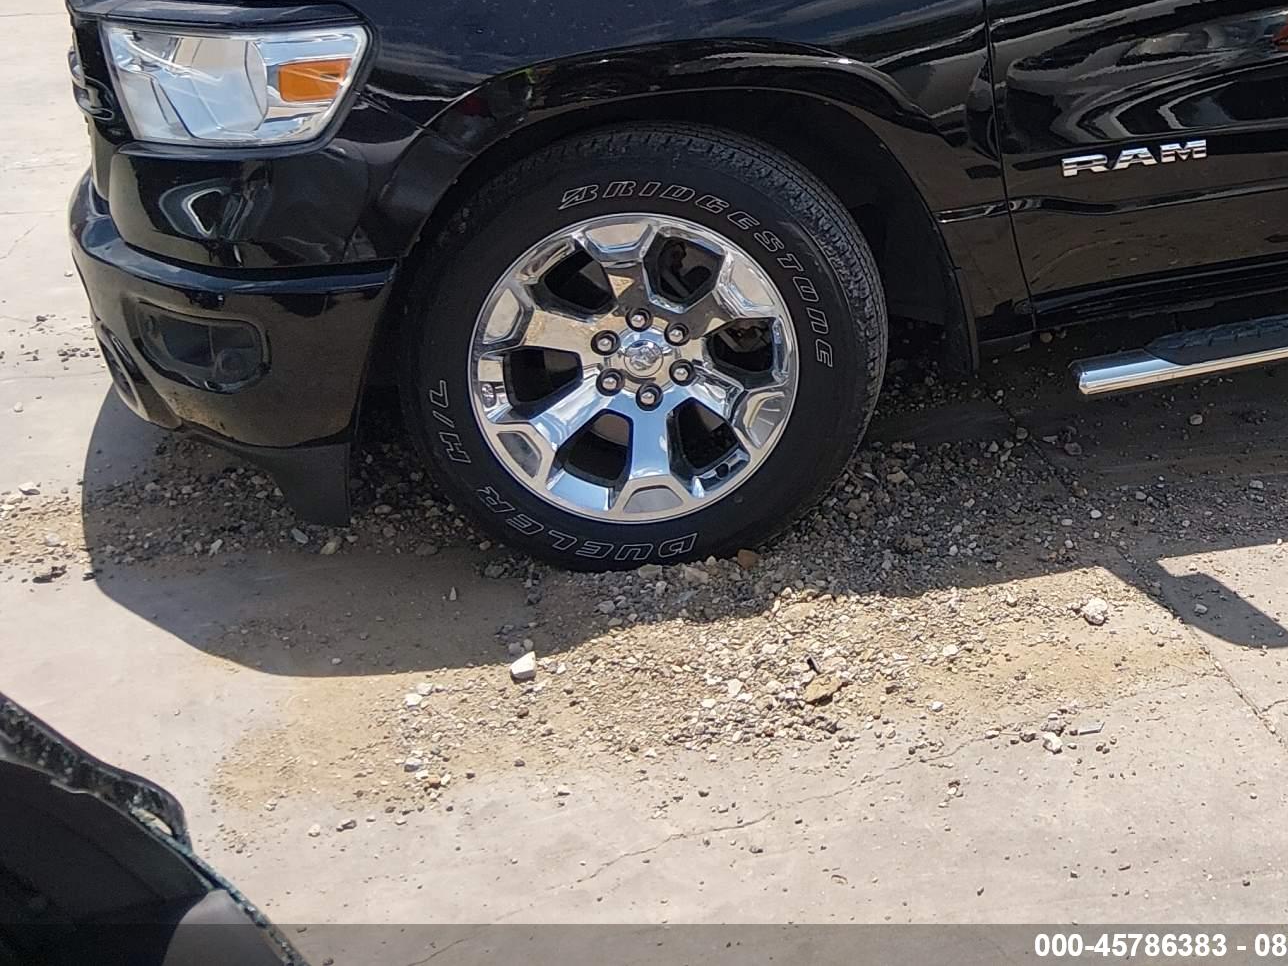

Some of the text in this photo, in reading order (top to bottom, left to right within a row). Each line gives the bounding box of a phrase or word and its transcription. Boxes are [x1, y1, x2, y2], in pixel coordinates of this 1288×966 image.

[1061, 139, 1207, 177] RAM
[558, 180, 834, 368] BRIDGESTONE
[430, 380, 698, 562] DUELER H/L
